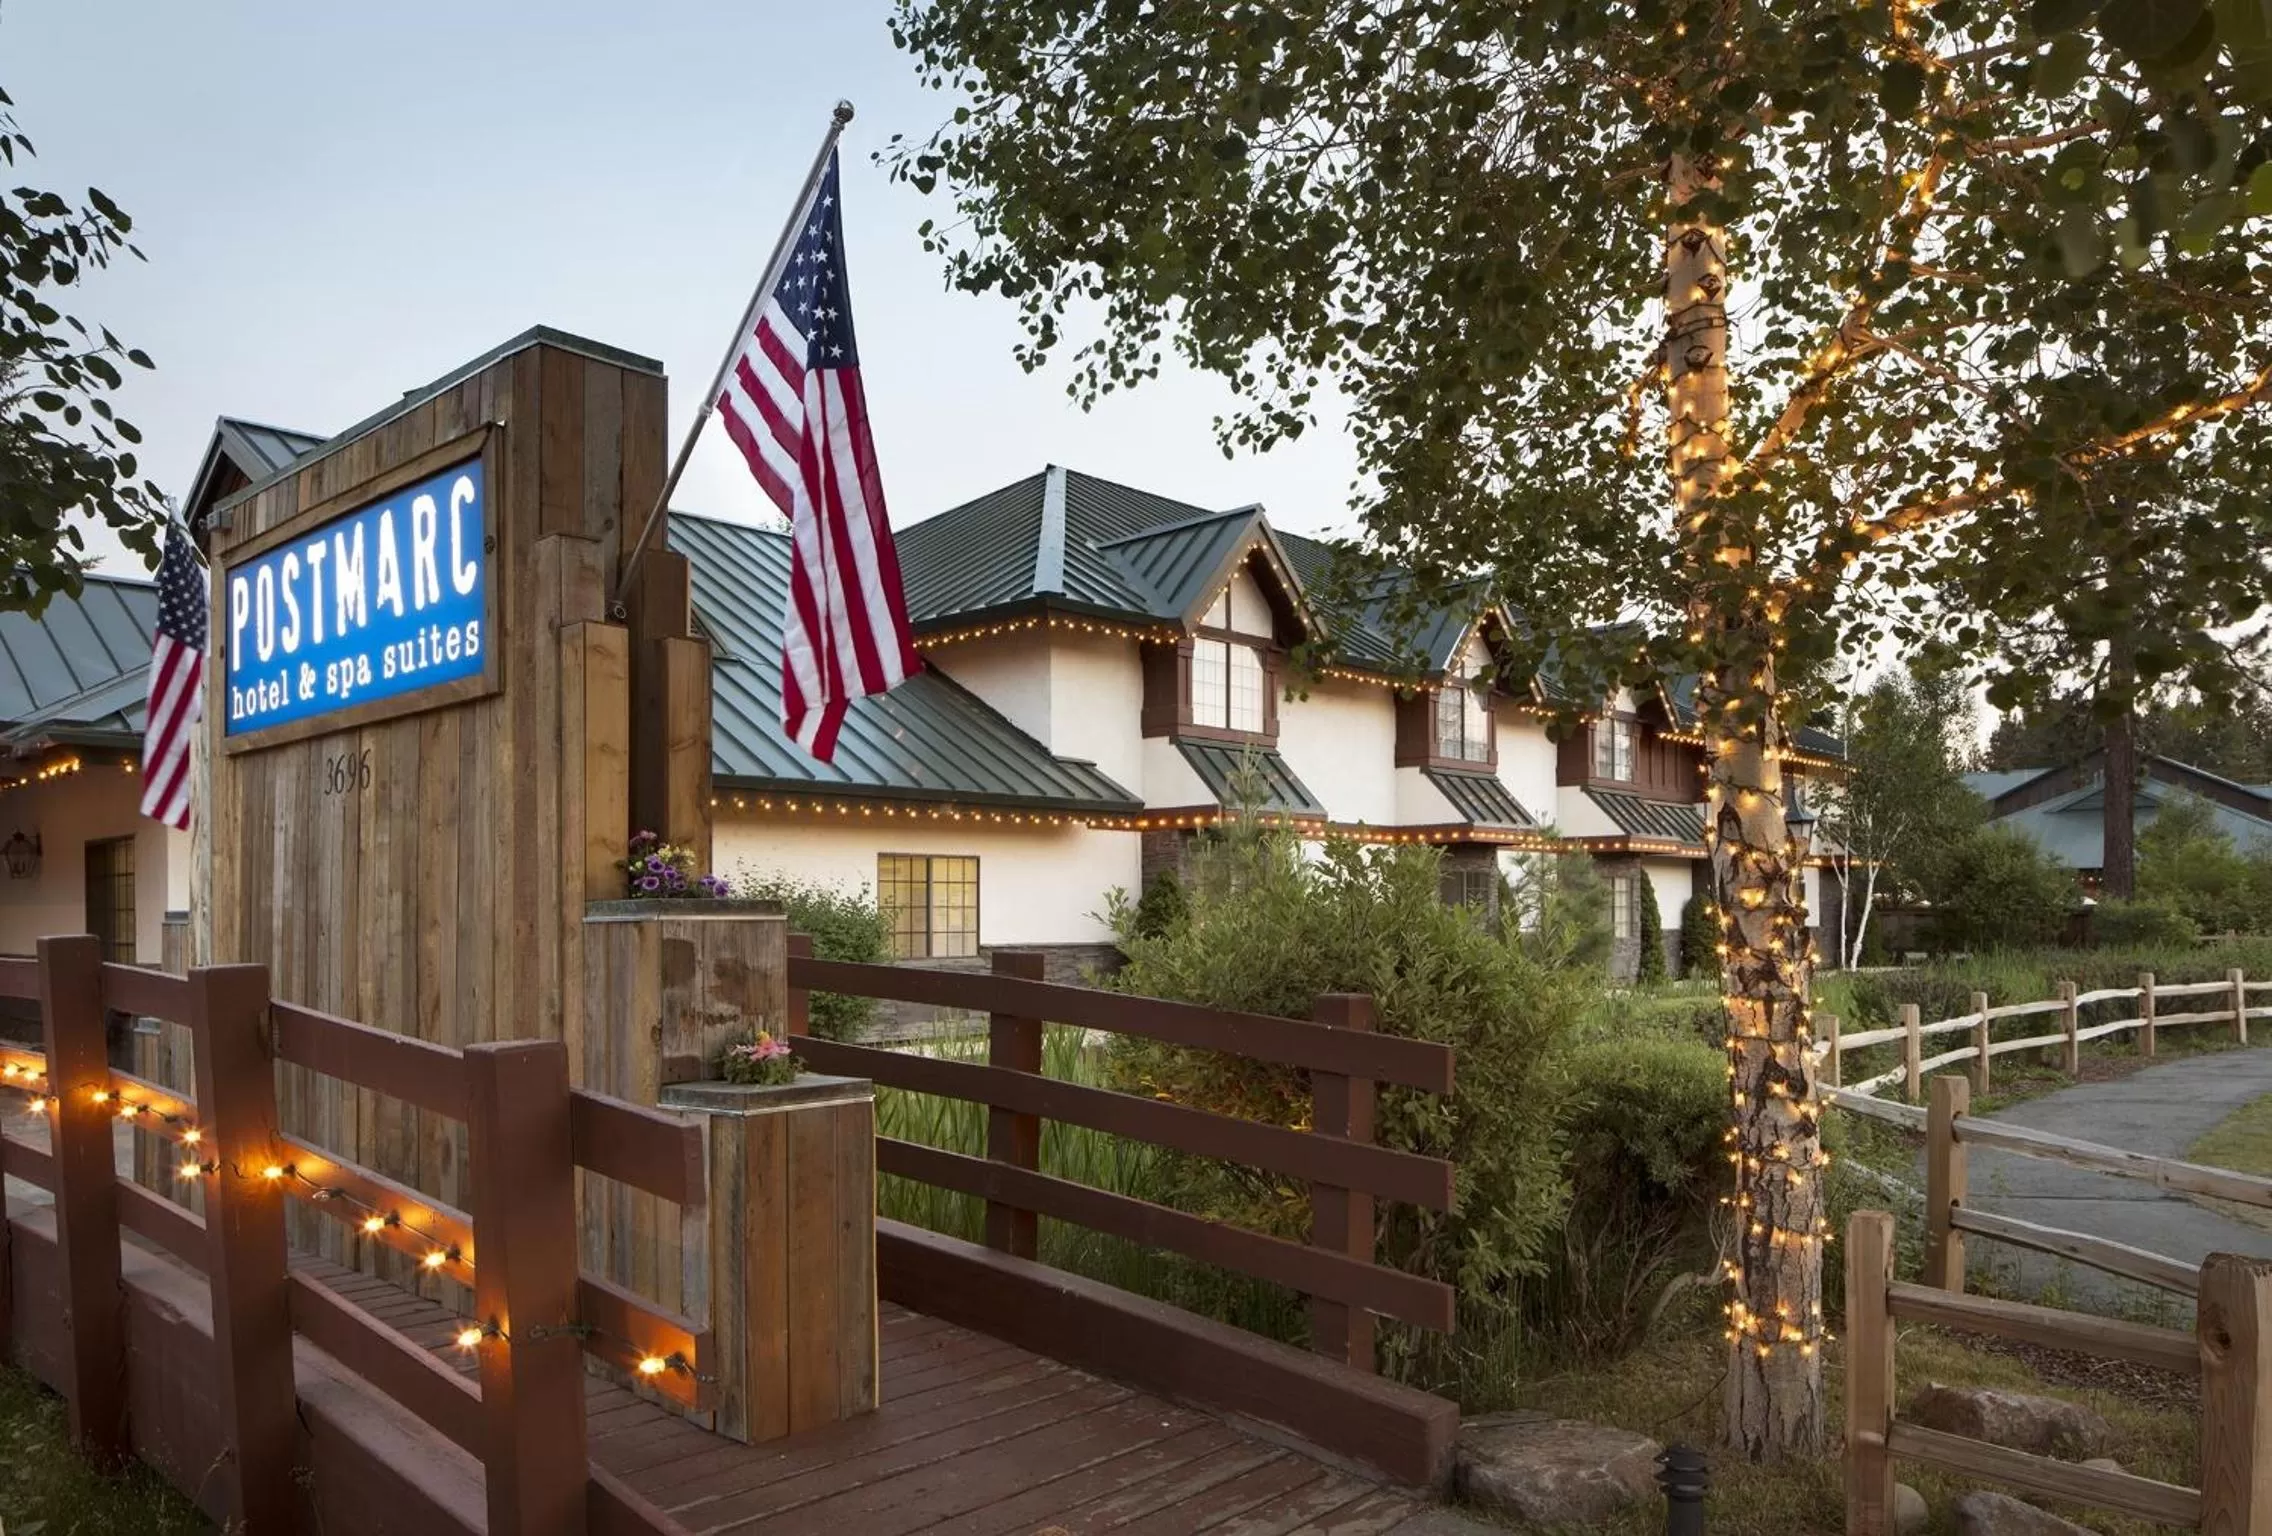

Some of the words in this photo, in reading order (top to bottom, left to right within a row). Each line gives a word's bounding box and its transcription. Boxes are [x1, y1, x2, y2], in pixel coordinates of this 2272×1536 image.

[232, 475, 478, 672] POSTMARC
[232, 669, 290, 721] hotel
[299, 661, 317, 702] &
[326, 653, 373, 700] spa
[383, 619, 480, 680] suites
[324, 748, 372, 796] 3696
